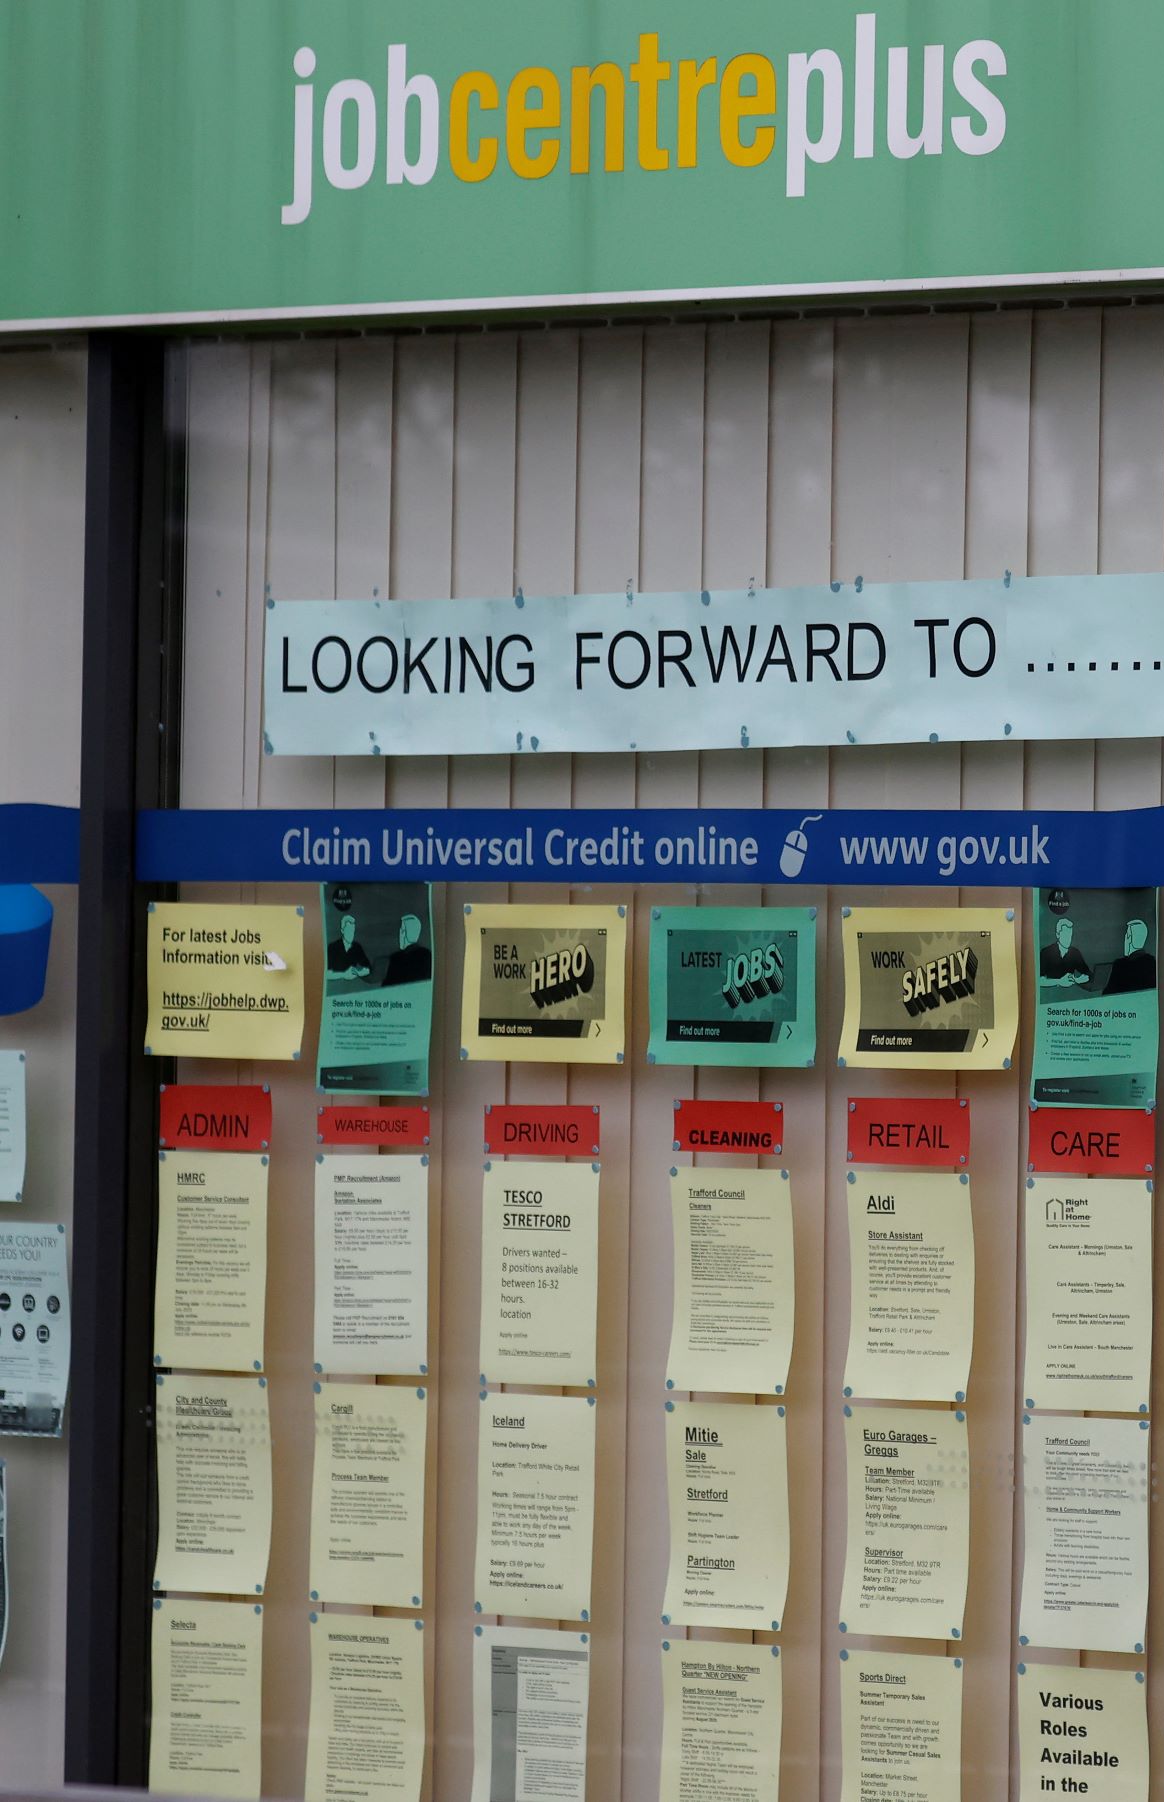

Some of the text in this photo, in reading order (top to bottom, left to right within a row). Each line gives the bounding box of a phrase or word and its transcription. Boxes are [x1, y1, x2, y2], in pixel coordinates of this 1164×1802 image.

[281, 12, 1008, 225] jobcentreplus
[281, 634, 536, 695] LOOKING
[574, 622, 887, 691] FORWARD
[914, 617, 997, 679] TO
[281, 825, 1050, 875] Claim Universal Credit online www.gov.uk
[163, 928, 261, 944] For latest Jobs
[162, 949, 239, 964] Information
[494, 945, 518, 960] BE A
[681, 952, 722, 967] LATEST
[871, 951, 905, 968] WORK
[494, 964, 526, 978] WORK
[530, 944, 590, 996] HERO
[722, 943, 781, 995] JOBS
[902, 947, 972, 1006] SAFELY
[162, 991, 289, 1012] https://jobhelp.dwp.
[1047, 1008, 1070, 1016] Search
[1072, 1008, 1081, 1016] for
[1083, 1009, 1102, 1017] 1000s
[1112, 1011, 1126, 1019] jobs
[162, 1014, 210, 1031] gov.uk/
[492, 1024, 532, 1034] Find out more
[680, 1025, 692, 1035] Find
[694, 1027, 703, 1035] out
[1047, 1020, 1102, 1028] gov.uk/find-a-job
[871, 1035, 912, 1045] Find out more
[177, 1114, 249, 1138] ADMIN
[335, 1119, 409, 1133] WAREHOUSE
[504, 1122, 579, 1143] DRIVING
[689, 1130, 772, 1148] CLEANING
[868, 1124, 950, 1149] RETAIL
[1050, 1130, 1121, 1158] CARE
[177, 1173, 206, 1186] HMRC
[503, 1190, 543, 1206] TESCO
[688, 1189, 745, 1200] Trafford Council
[867, 1195, 895, 1213] Aldi
[503, 1213, 571, 1230] STRETFORD
[868, 1231, 923, 1241] Store Assistant
[502, 1247, 560, 1258] Drivers wanted
[502, 1263, 578, 1274] 8 positions available
[501, 1279, 559, 1289] between 16-32
[500, 1308, 531, 1319] location
[331, 1403, 353, 1415] Cargill
[492, 1415, 525, 1428] Iceland
[685, 1427, 719, 1445] Mitie
[863, 1429, 928, 1443] Euro Garages
[686, 1450, 706, 1462] Sale
[864, 1444, 899, 1457] Greggs
[865, 1466, 915, 1477] Team Member
[687, 1488, 728, 1502] Stretford
[865, 1547, 903, 1558] Supervisor
[687, 1555, 735, 1570] Partington
[170, 1620, 197, 1630] Selecta
[860, 1673, 906, 1684] Sports Direct
[1039, 1692, 1104, 1711] Various
[1040, 1720, 1087, 1737] Roles
[1040, 1748, 1119, 1767] Available
[1041, 1776, 1088, 1793] in the
